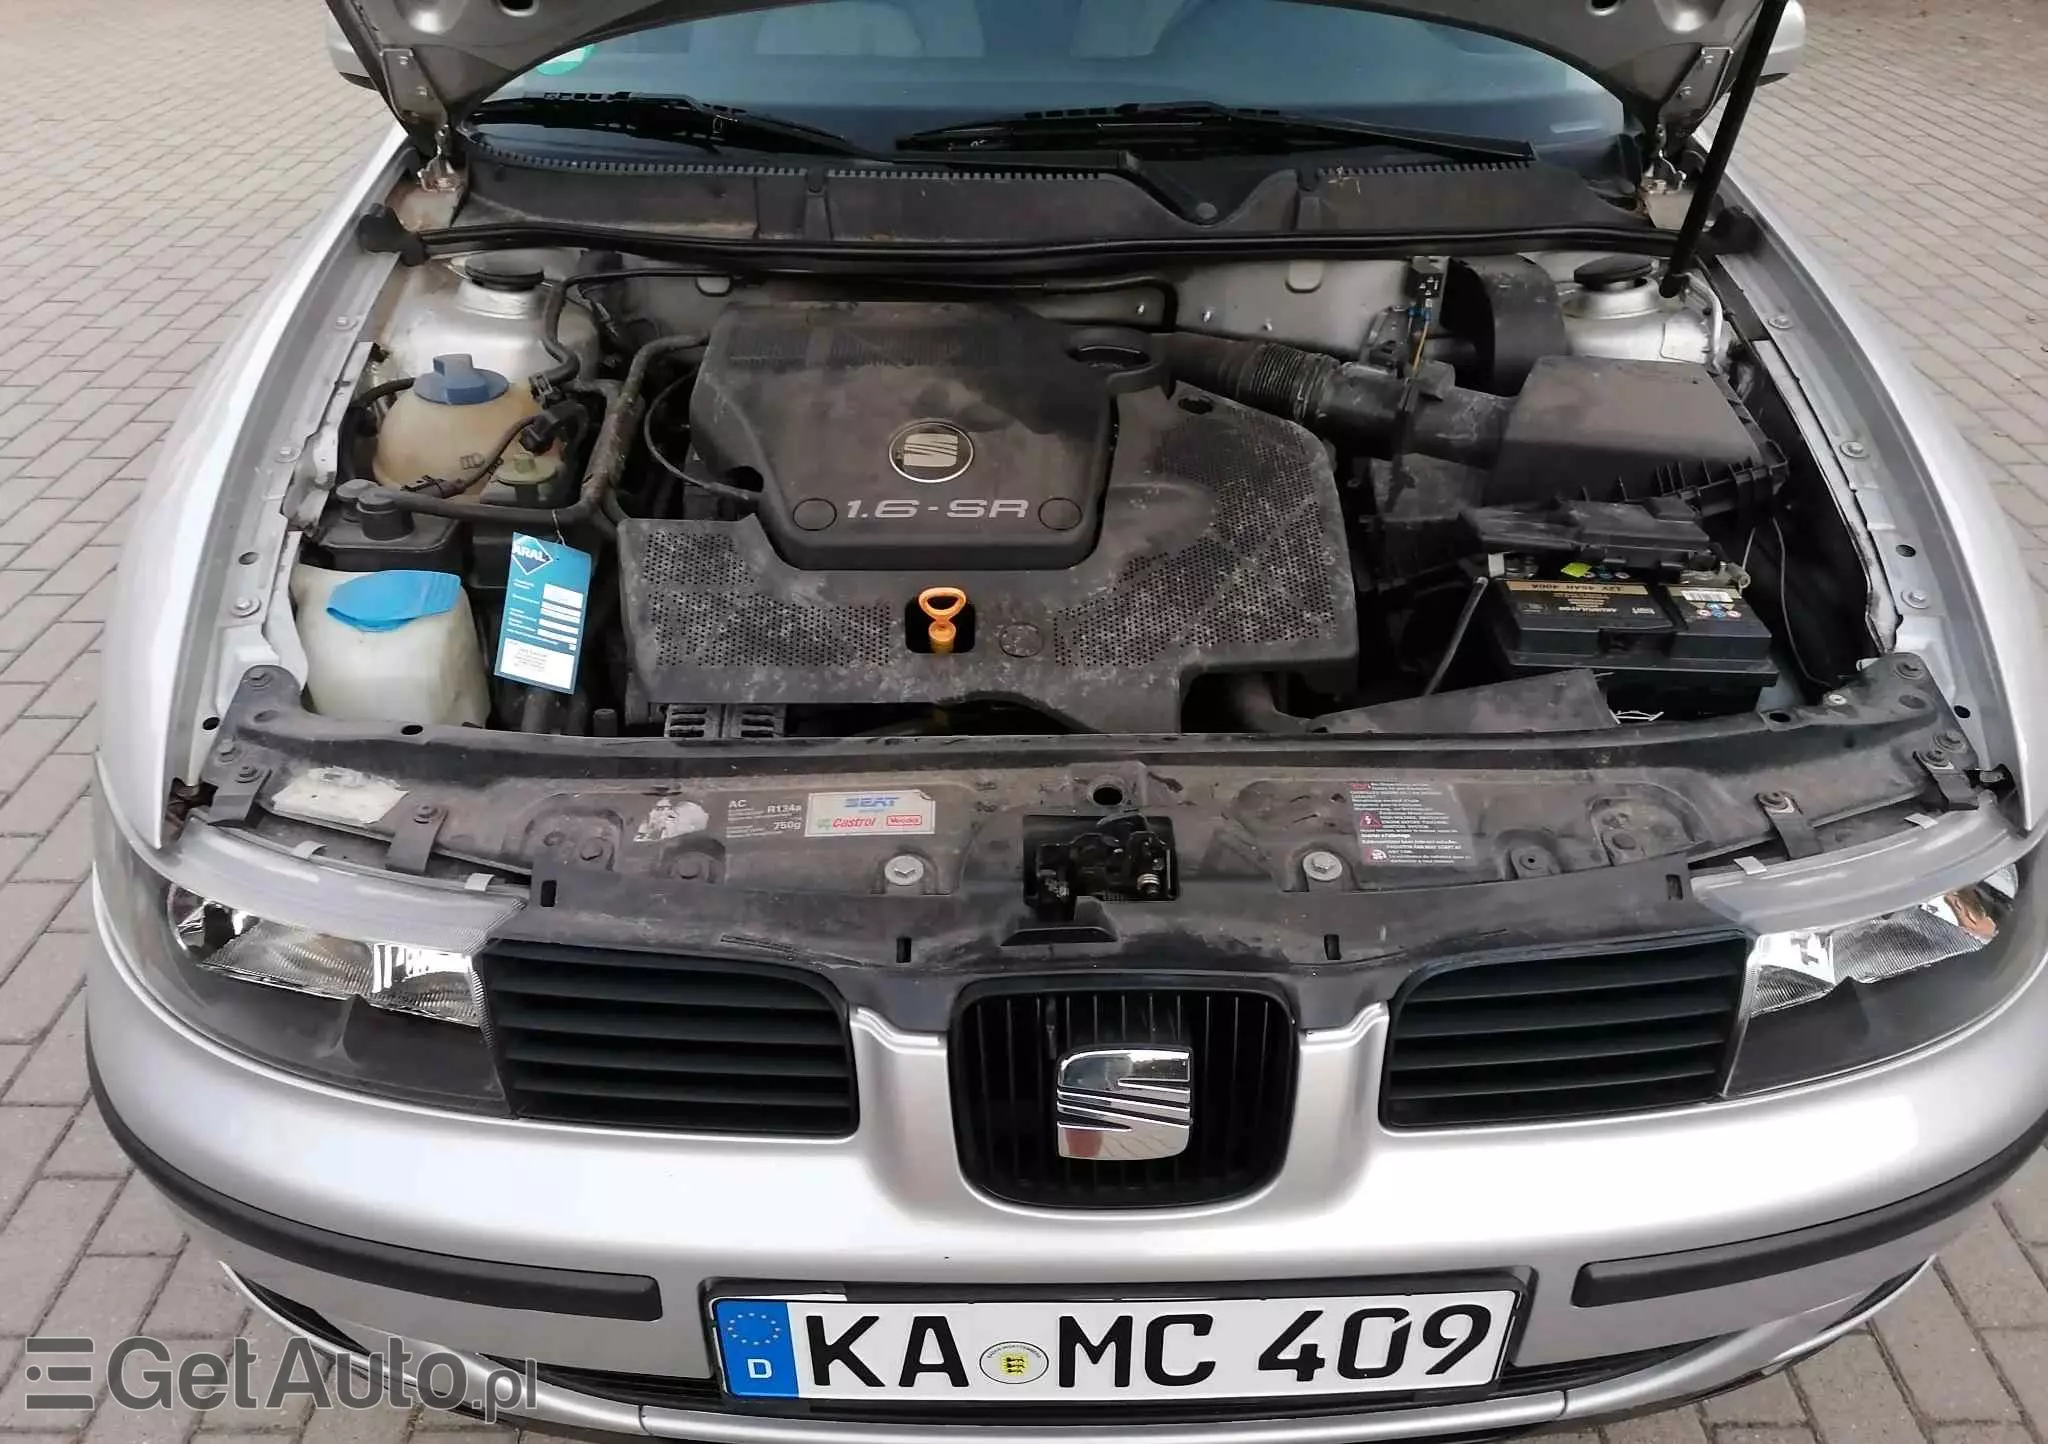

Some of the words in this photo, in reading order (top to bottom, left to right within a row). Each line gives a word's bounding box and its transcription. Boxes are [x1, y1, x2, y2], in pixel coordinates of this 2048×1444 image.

[512, 543, 546, 563] ARAL
[728, 799, 748, 809] AC
[767, 803, 802, 814] R134a
[844, 797, 900, 808] SEAT
[773, 820, 802, 832] 750g
[832, 815, 876, 828] Castrol
[805, 1315, 970, 1388] KA
[1058, 1314, 1216, 1389] MC
[1257, 1304, 1492, 1386] 409
[748, 1358, 771, 1380] D
